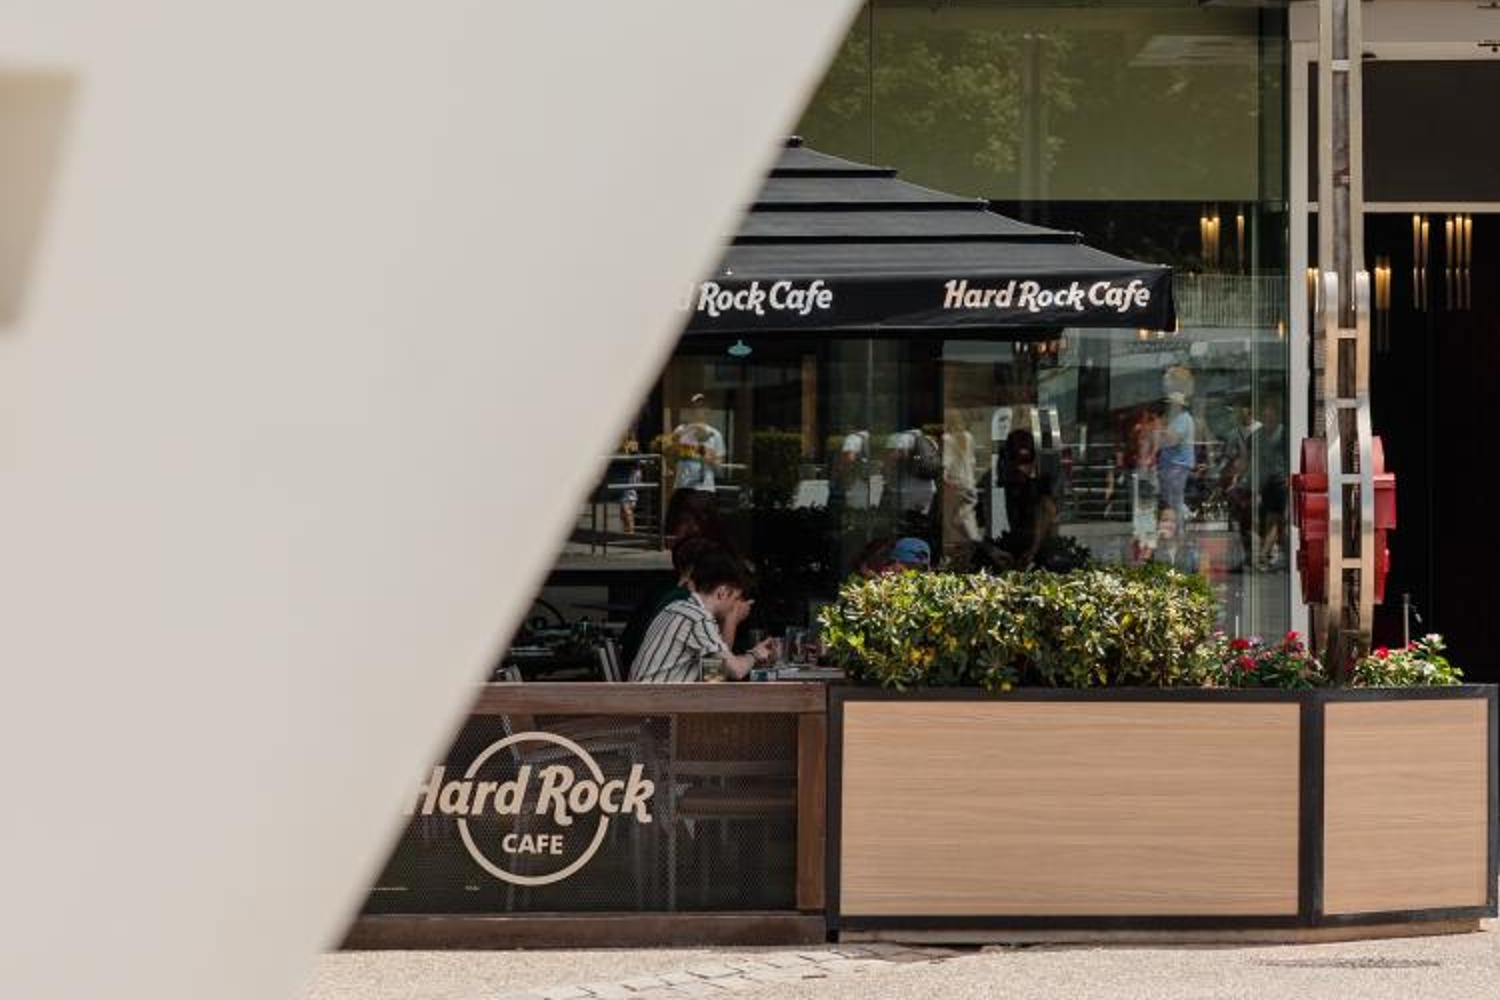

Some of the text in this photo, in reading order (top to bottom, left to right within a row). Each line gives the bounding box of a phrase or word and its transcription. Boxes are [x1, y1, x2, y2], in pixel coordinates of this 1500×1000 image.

[697, 280, 767, 317] Rock
[768, 280, 833, 316] Cafe
[943, 279, 1151, 313] Hard Rock Cafe
[534, 763, 656, 827] Rock
[501, 832, 564, 856] CAFE
